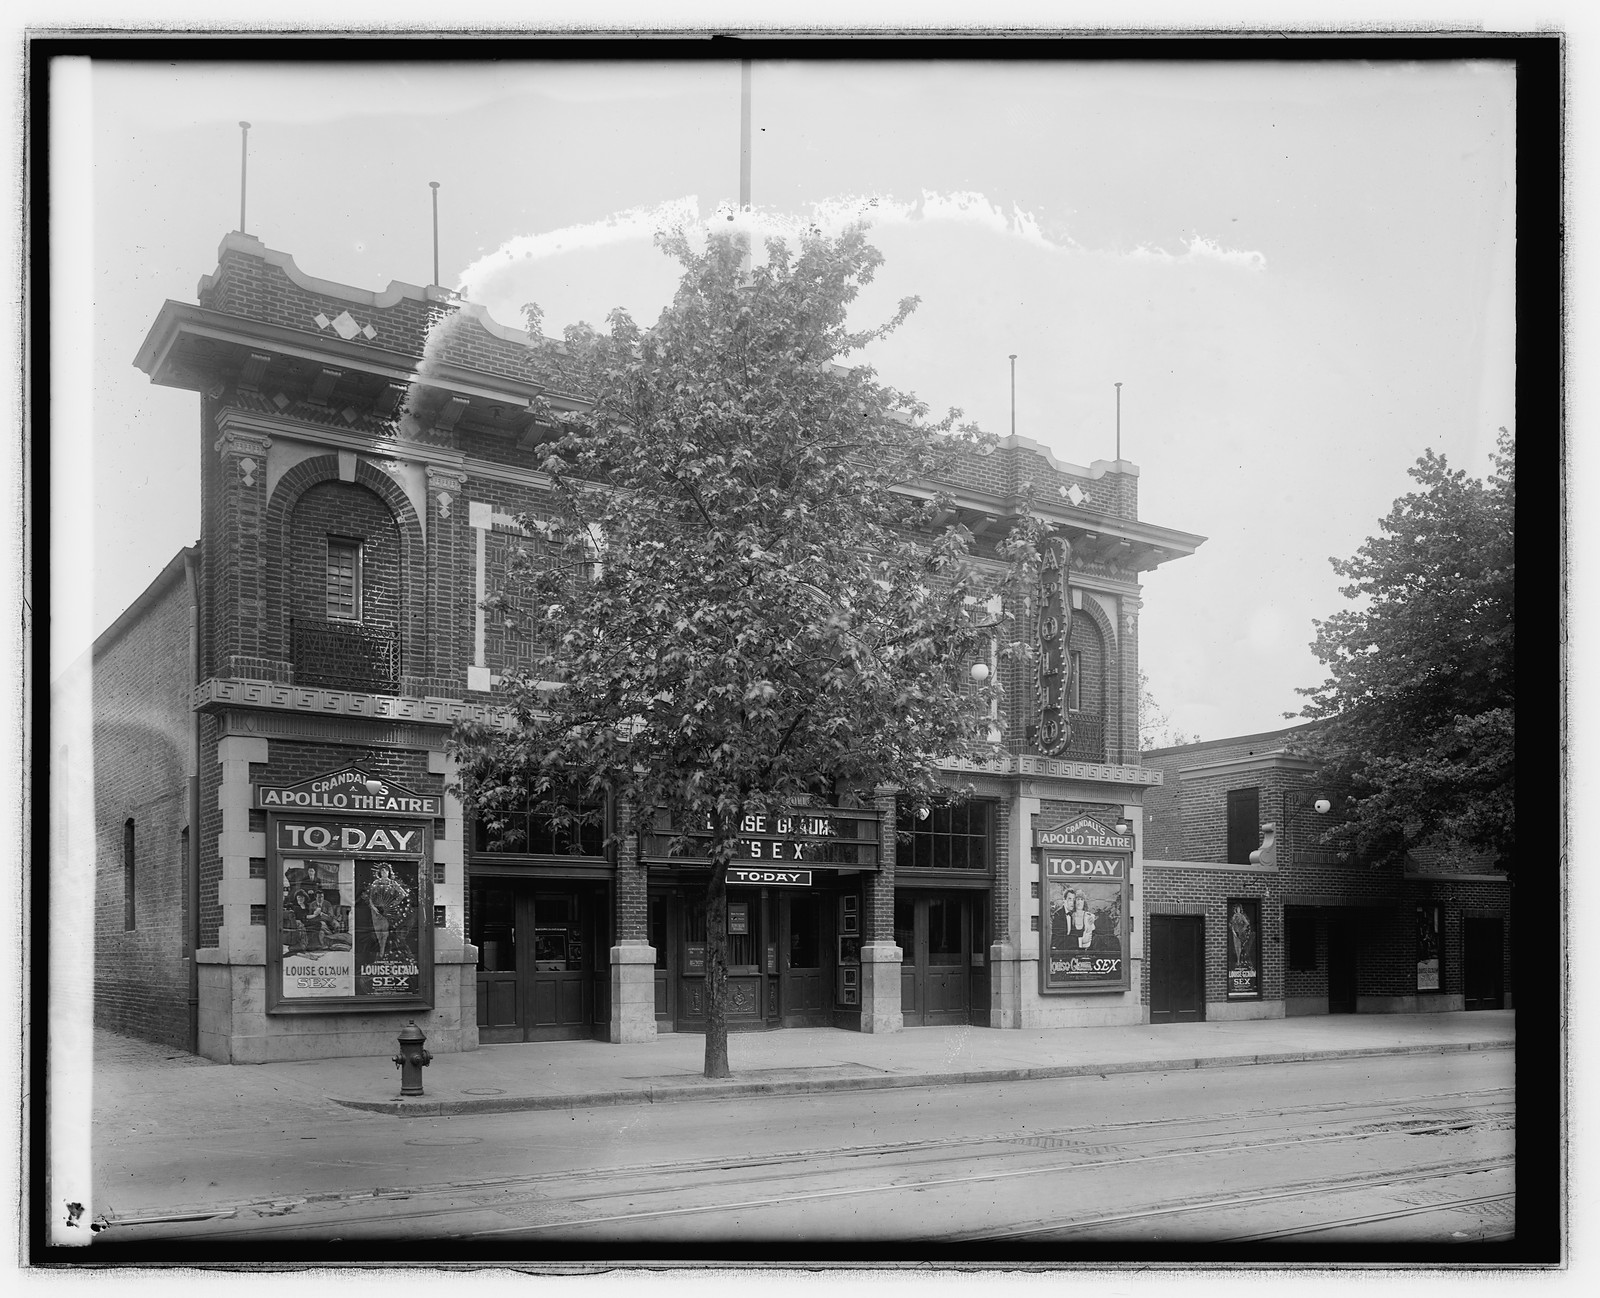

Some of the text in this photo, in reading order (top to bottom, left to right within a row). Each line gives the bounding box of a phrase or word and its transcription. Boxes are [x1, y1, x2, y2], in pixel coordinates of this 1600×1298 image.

[1041, 547, 1059, 744] APOLLO
[264, 790, 434, 812] APOLLO THEATRE
[1065, 819, 1106, 836] CRANDALL'S
[284, 825, 415, 850] TO-DAY
[1041, 833, 1131, 847] APOLLO THEATRE
[1049, 858, 1119, 875] TO-DAY
[285, 966, 349, 976] LOUISE GLAUM
[360, 964, 390, 976] LOUISE
[1093, 959, 1121, 974] SEX
[297, 977, 336, 988] SEX
[372, 976, 410, 987] SEX
[1233, 978, 1251, 986] SEX
